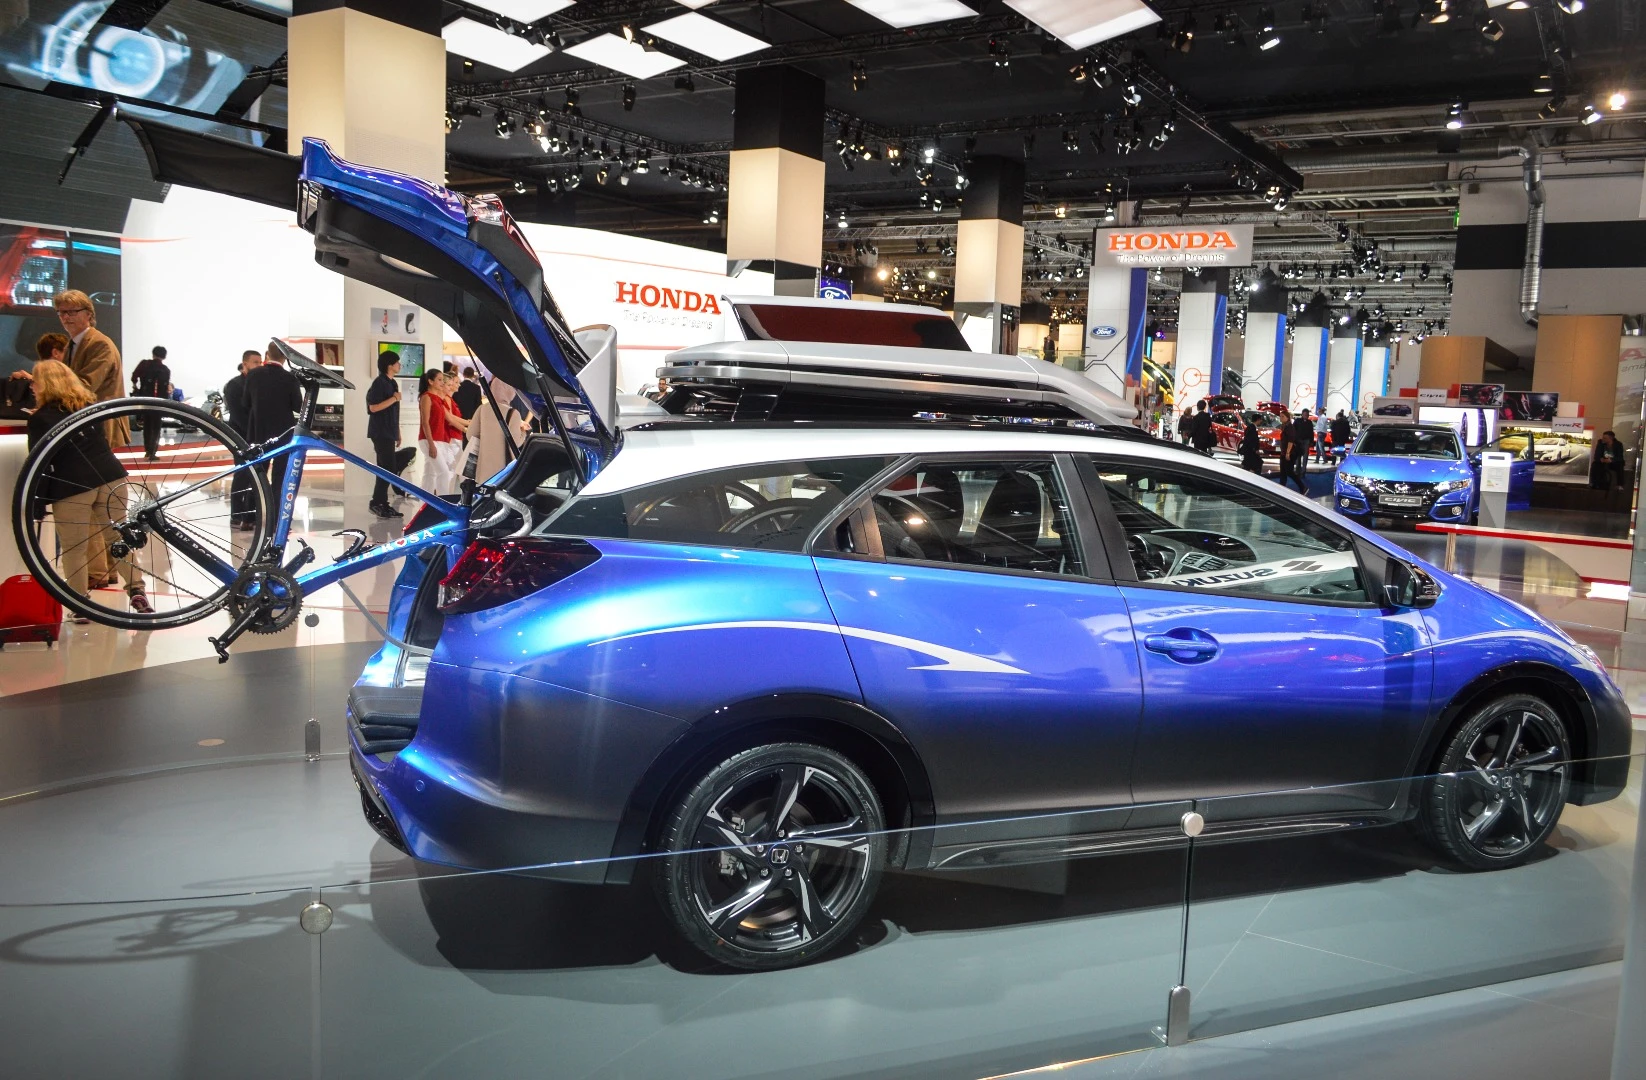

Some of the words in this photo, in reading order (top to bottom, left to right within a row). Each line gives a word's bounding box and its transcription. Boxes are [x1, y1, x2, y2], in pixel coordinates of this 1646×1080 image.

[1108, 231, 1237, 251] HONDA
[1117, 253, 1136, 263] The
[1137, 253, 1169, 263] Power
[1170, 252, 1182, 262] of
[1183, 252, 1225, 262] Dreams
[614, 281, 722, 316] HONDA
[1096, 327, 1112, 336] Ford
[290, 458, 302, 478] DE
[281, 482, 297, 521] ROSA
[381, 529, 436, 553] ROSA
